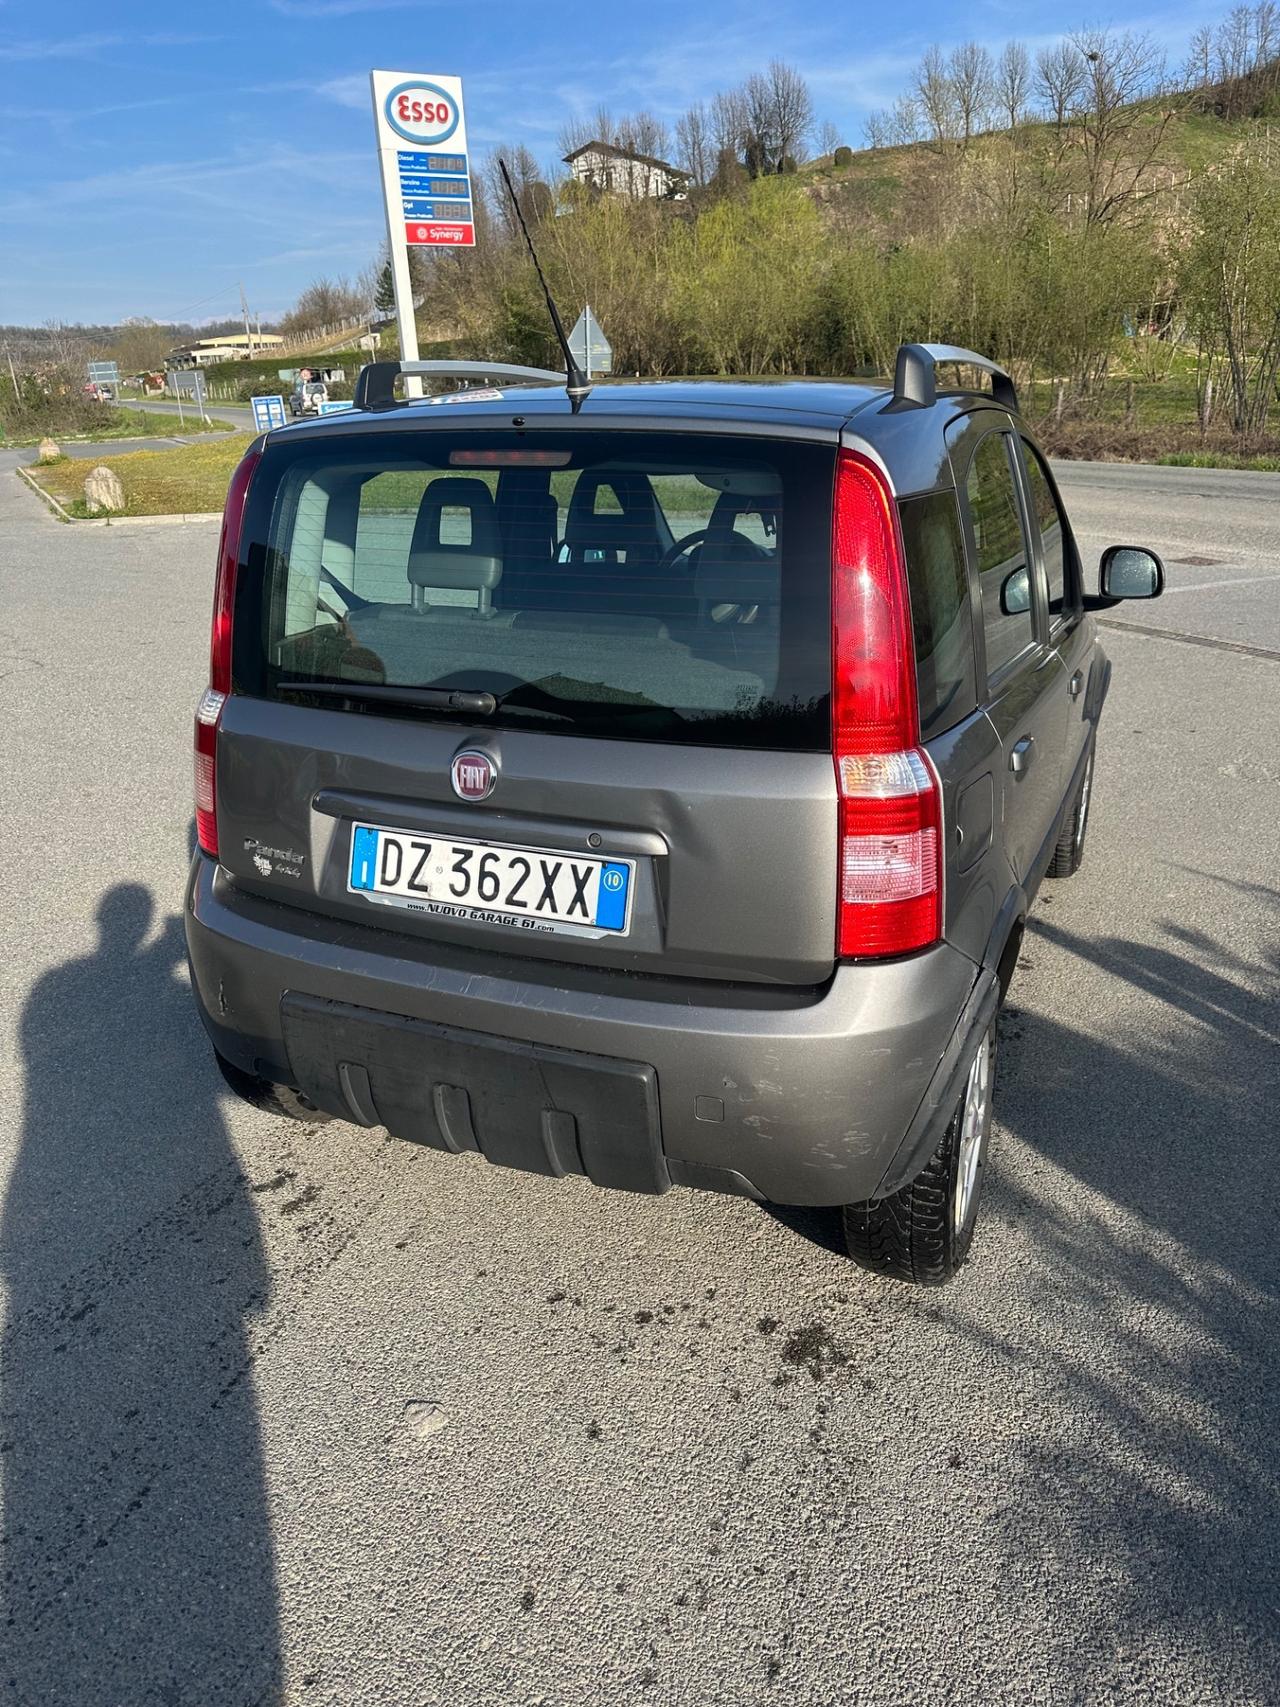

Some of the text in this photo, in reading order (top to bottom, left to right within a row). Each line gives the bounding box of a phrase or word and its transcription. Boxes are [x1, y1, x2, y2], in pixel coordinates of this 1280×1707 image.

[430, 228, 464, 242] Synergy
[460, 764, 487, 789] FIAT
[606, 874, 619, 888] 10
[407, 903, 555, 933] www.NUOVO GARAGE 61.com
